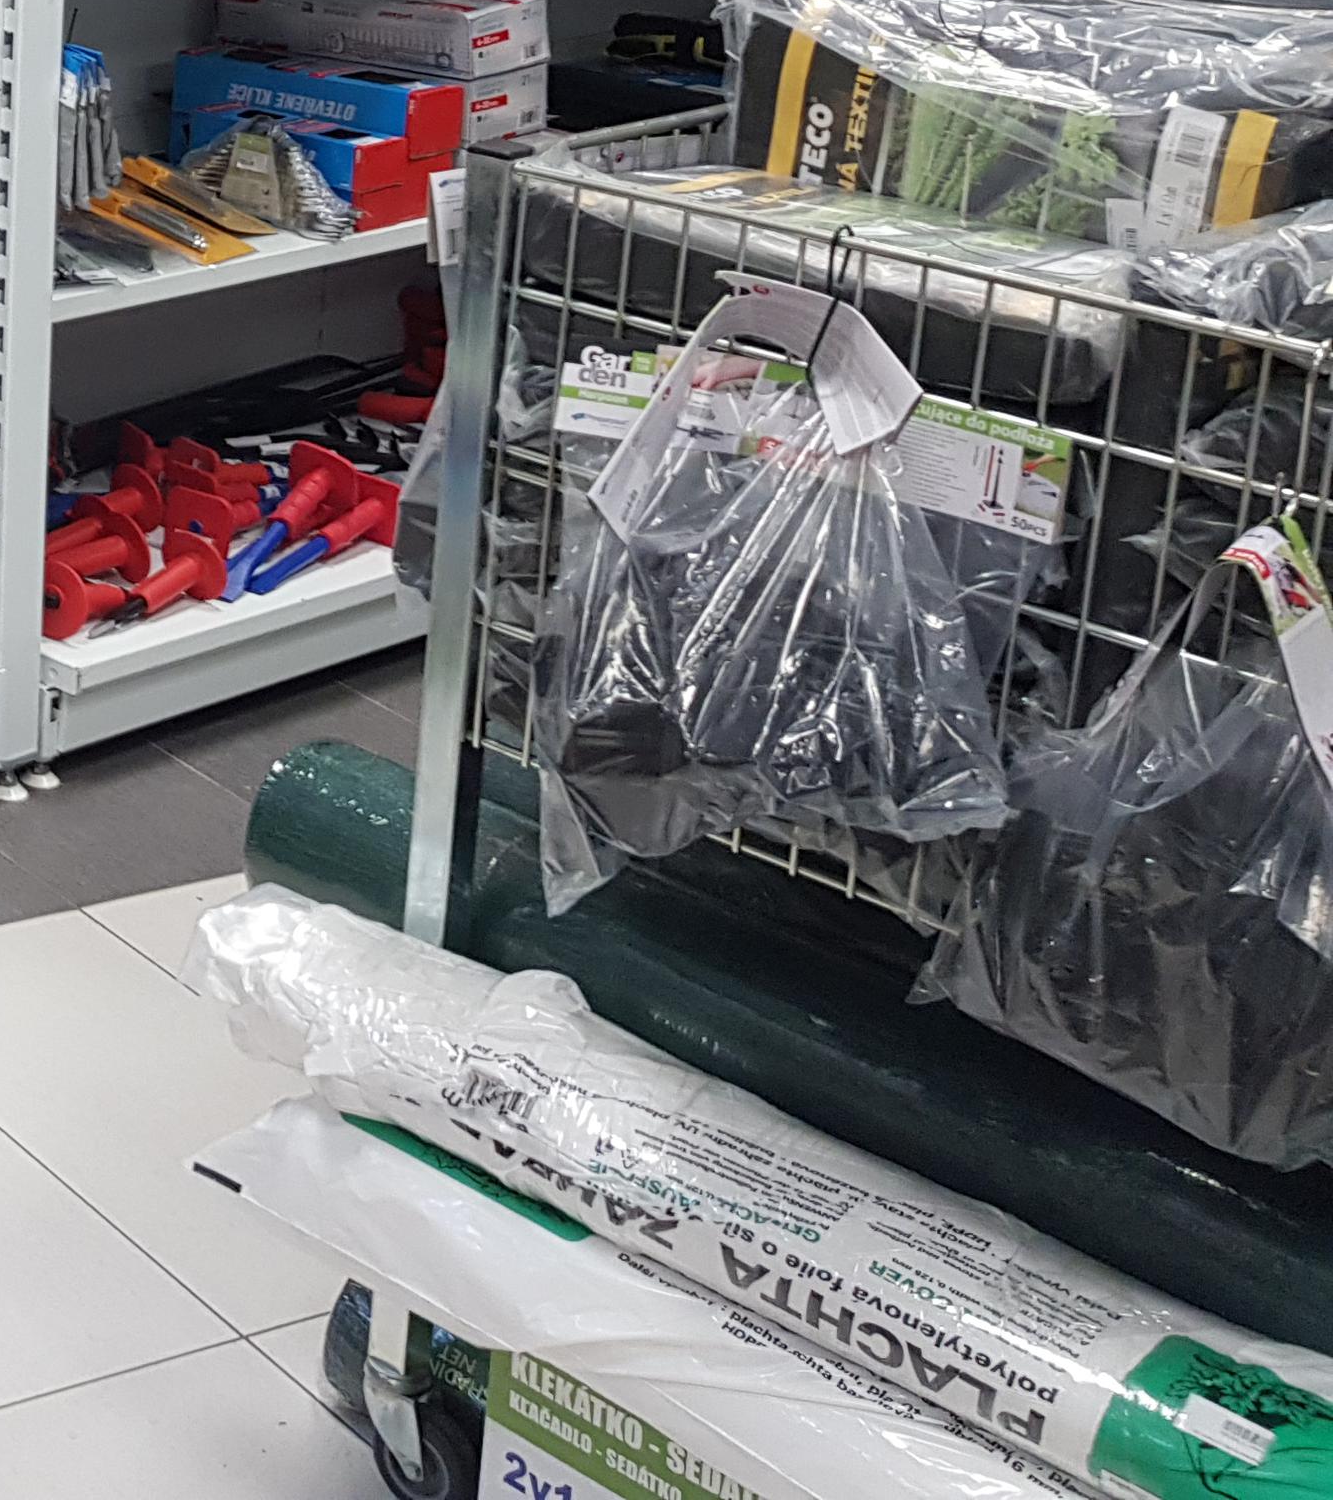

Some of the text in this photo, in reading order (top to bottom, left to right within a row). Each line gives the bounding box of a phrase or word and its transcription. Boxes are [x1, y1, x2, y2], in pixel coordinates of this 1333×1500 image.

[798, 102, 834, 184] TECO
[578, 365, 628, 389] den
[580, 345, 630, 373] Gar
[964, 414, 984, 431] do
[987, 417, 1055, 451] podłoża
[761, 1240, 778, 1257] o
[784, 1252, 845, 1293] folie
[438, 1344, 478, 1377] NET
[719, 1242, 1047, 1447] PLACHTA
[851, 1285, 1059, 1405] polyetylenová
[510, 1349, 643, 1451] KLEKÁTKO
[502, 1450, 575, 1500] 2v1
[604, 1449, 682, 1500] SEDÁTKO
